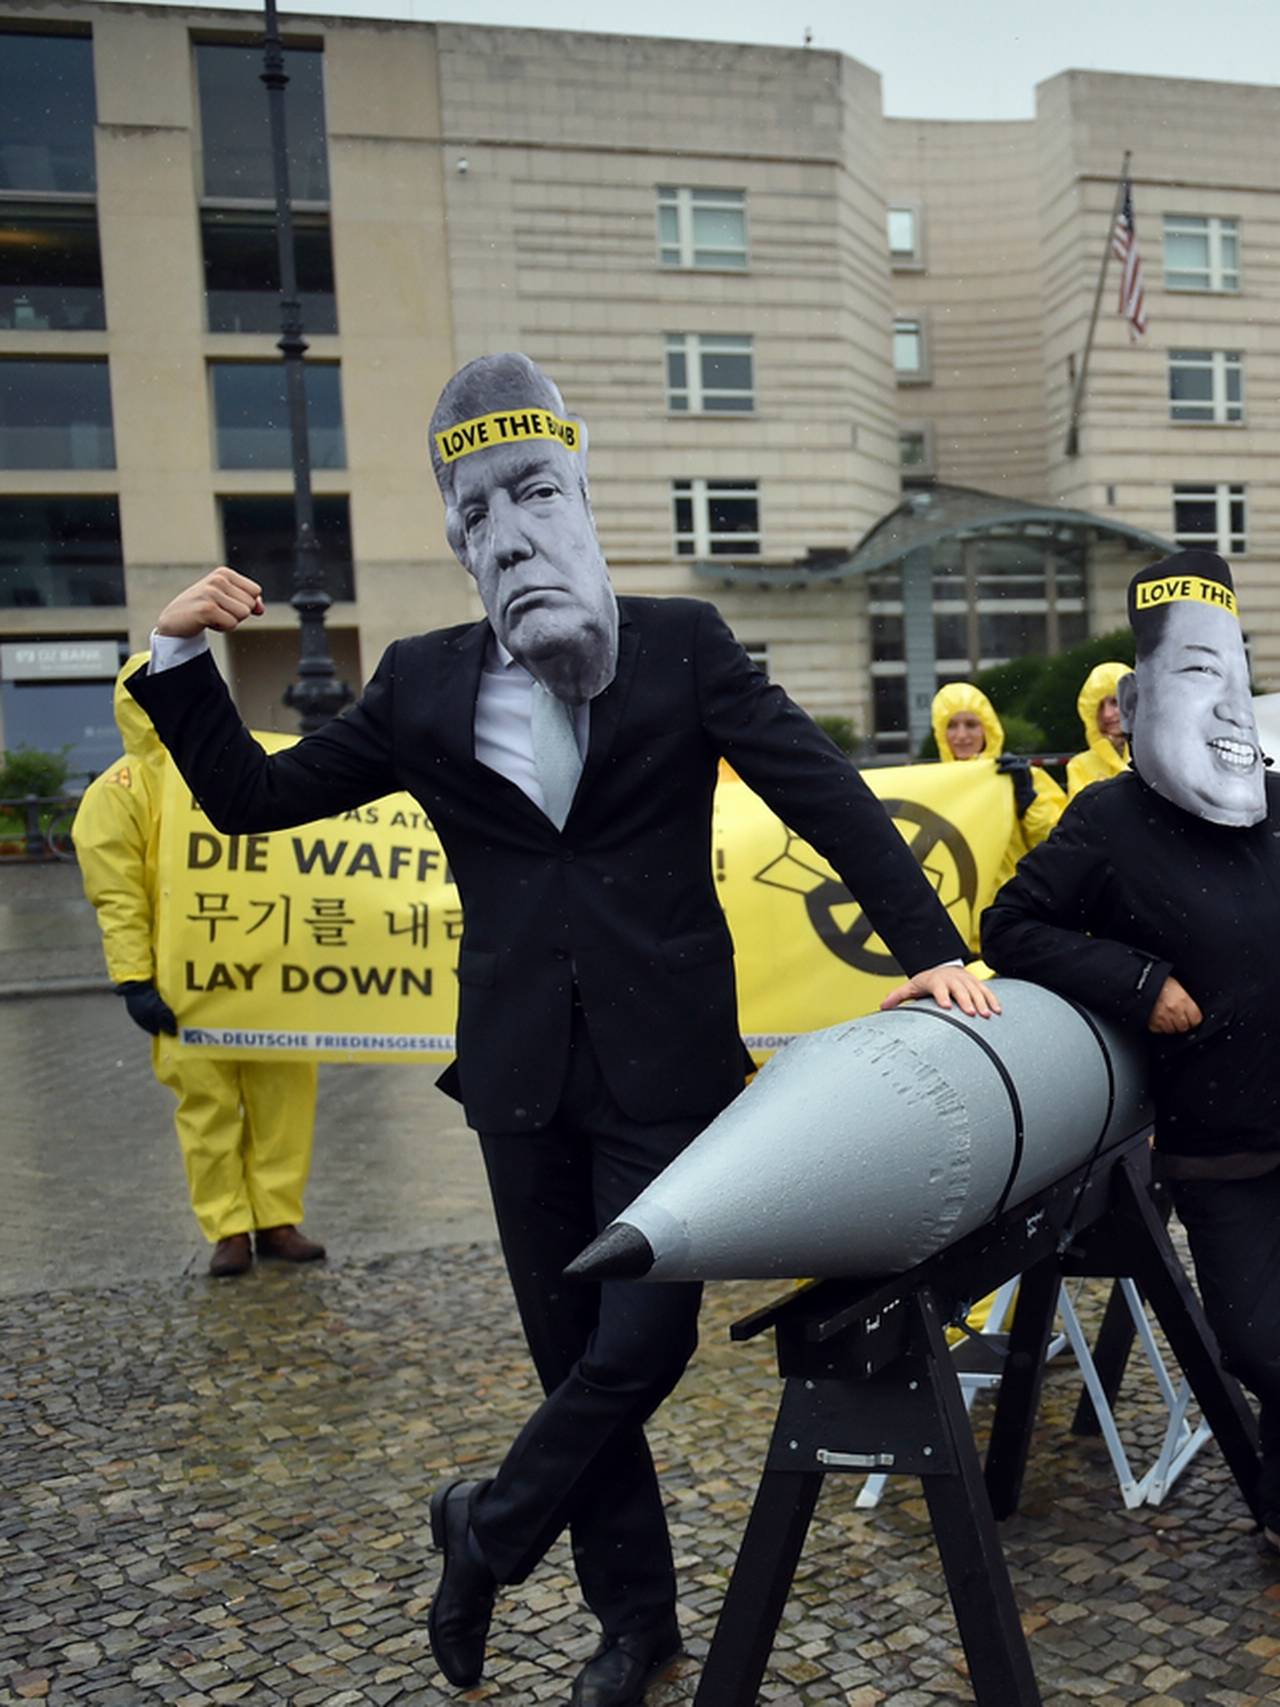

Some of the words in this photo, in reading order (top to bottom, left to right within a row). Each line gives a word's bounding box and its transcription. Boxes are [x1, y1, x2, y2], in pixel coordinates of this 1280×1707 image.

[443, 422, 489, 456] LOVE
[493, 413, 543, 438] THE
[1141, 580, 1191, 604] LOVE
[1200, 583, 1233, 610] THE
[186, 832, 269, 872] DIE
[186, 891, 355, 947] 무기를
[185, 961, 262, 992] LAY
[281, 964, 433, 997] DOWN
[222, 1031, 309, 1047] DEUTSCHE
